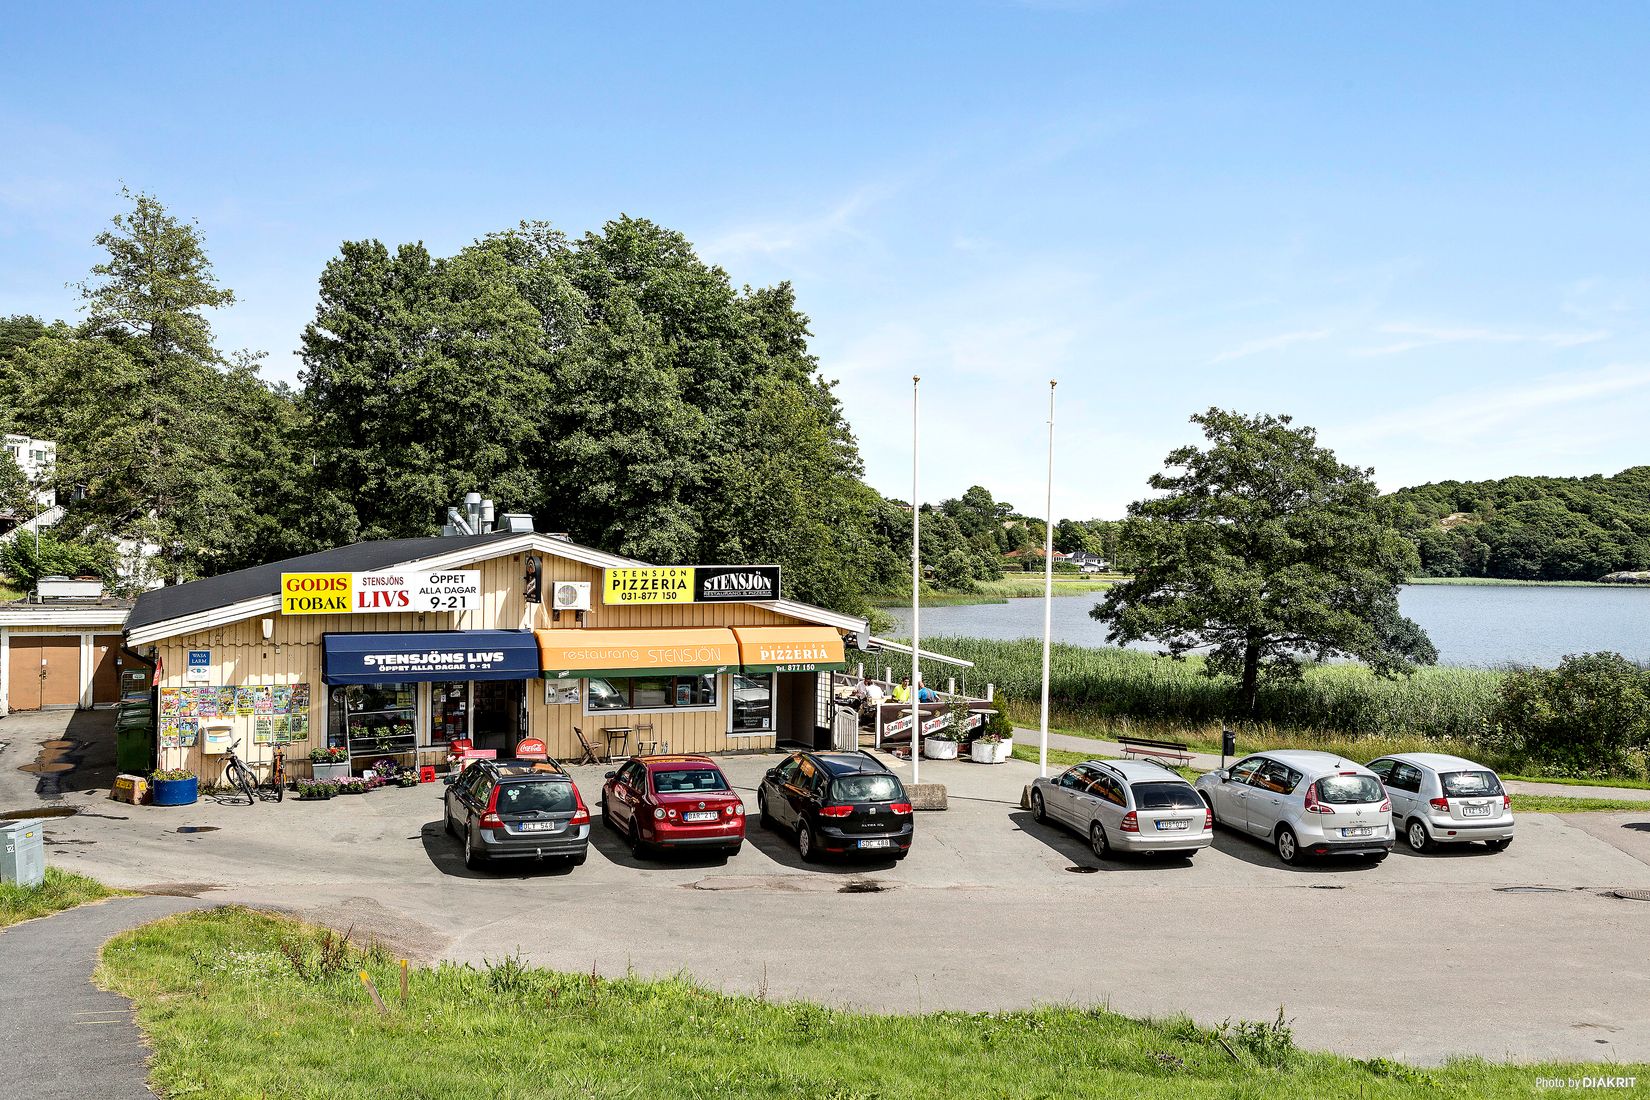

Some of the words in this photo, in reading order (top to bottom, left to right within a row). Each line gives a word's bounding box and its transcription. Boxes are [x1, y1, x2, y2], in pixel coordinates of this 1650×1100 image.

[362, 575, 404, 586] STENSJÖNS
[429, 572, 466, 584] ÖPPET
[703, 571, 772, 591] STENSJÖN
[286, 577, 348, 592] GODIS
[444, 586, 477, 594] DAGAR
[612, 579, 687, 590] PIZZERIA
[358, 590, 410, 608] LIVS
[621, 592, 658, 600] 031-877
[286, 596, 347, 610] TOBAK
[430, 596, 467, 609] 9-21
[363, 651, 464, 665] STENSJÖNS
[467, 651, 504, 663] LIVS
[563, 648, 640, 661] restaurang
[647, 646, 721, 663] STENSJÖN
[760, 648, 828, 660] PIZZERIA
[378, 664, 409, 672] ÖPPET
